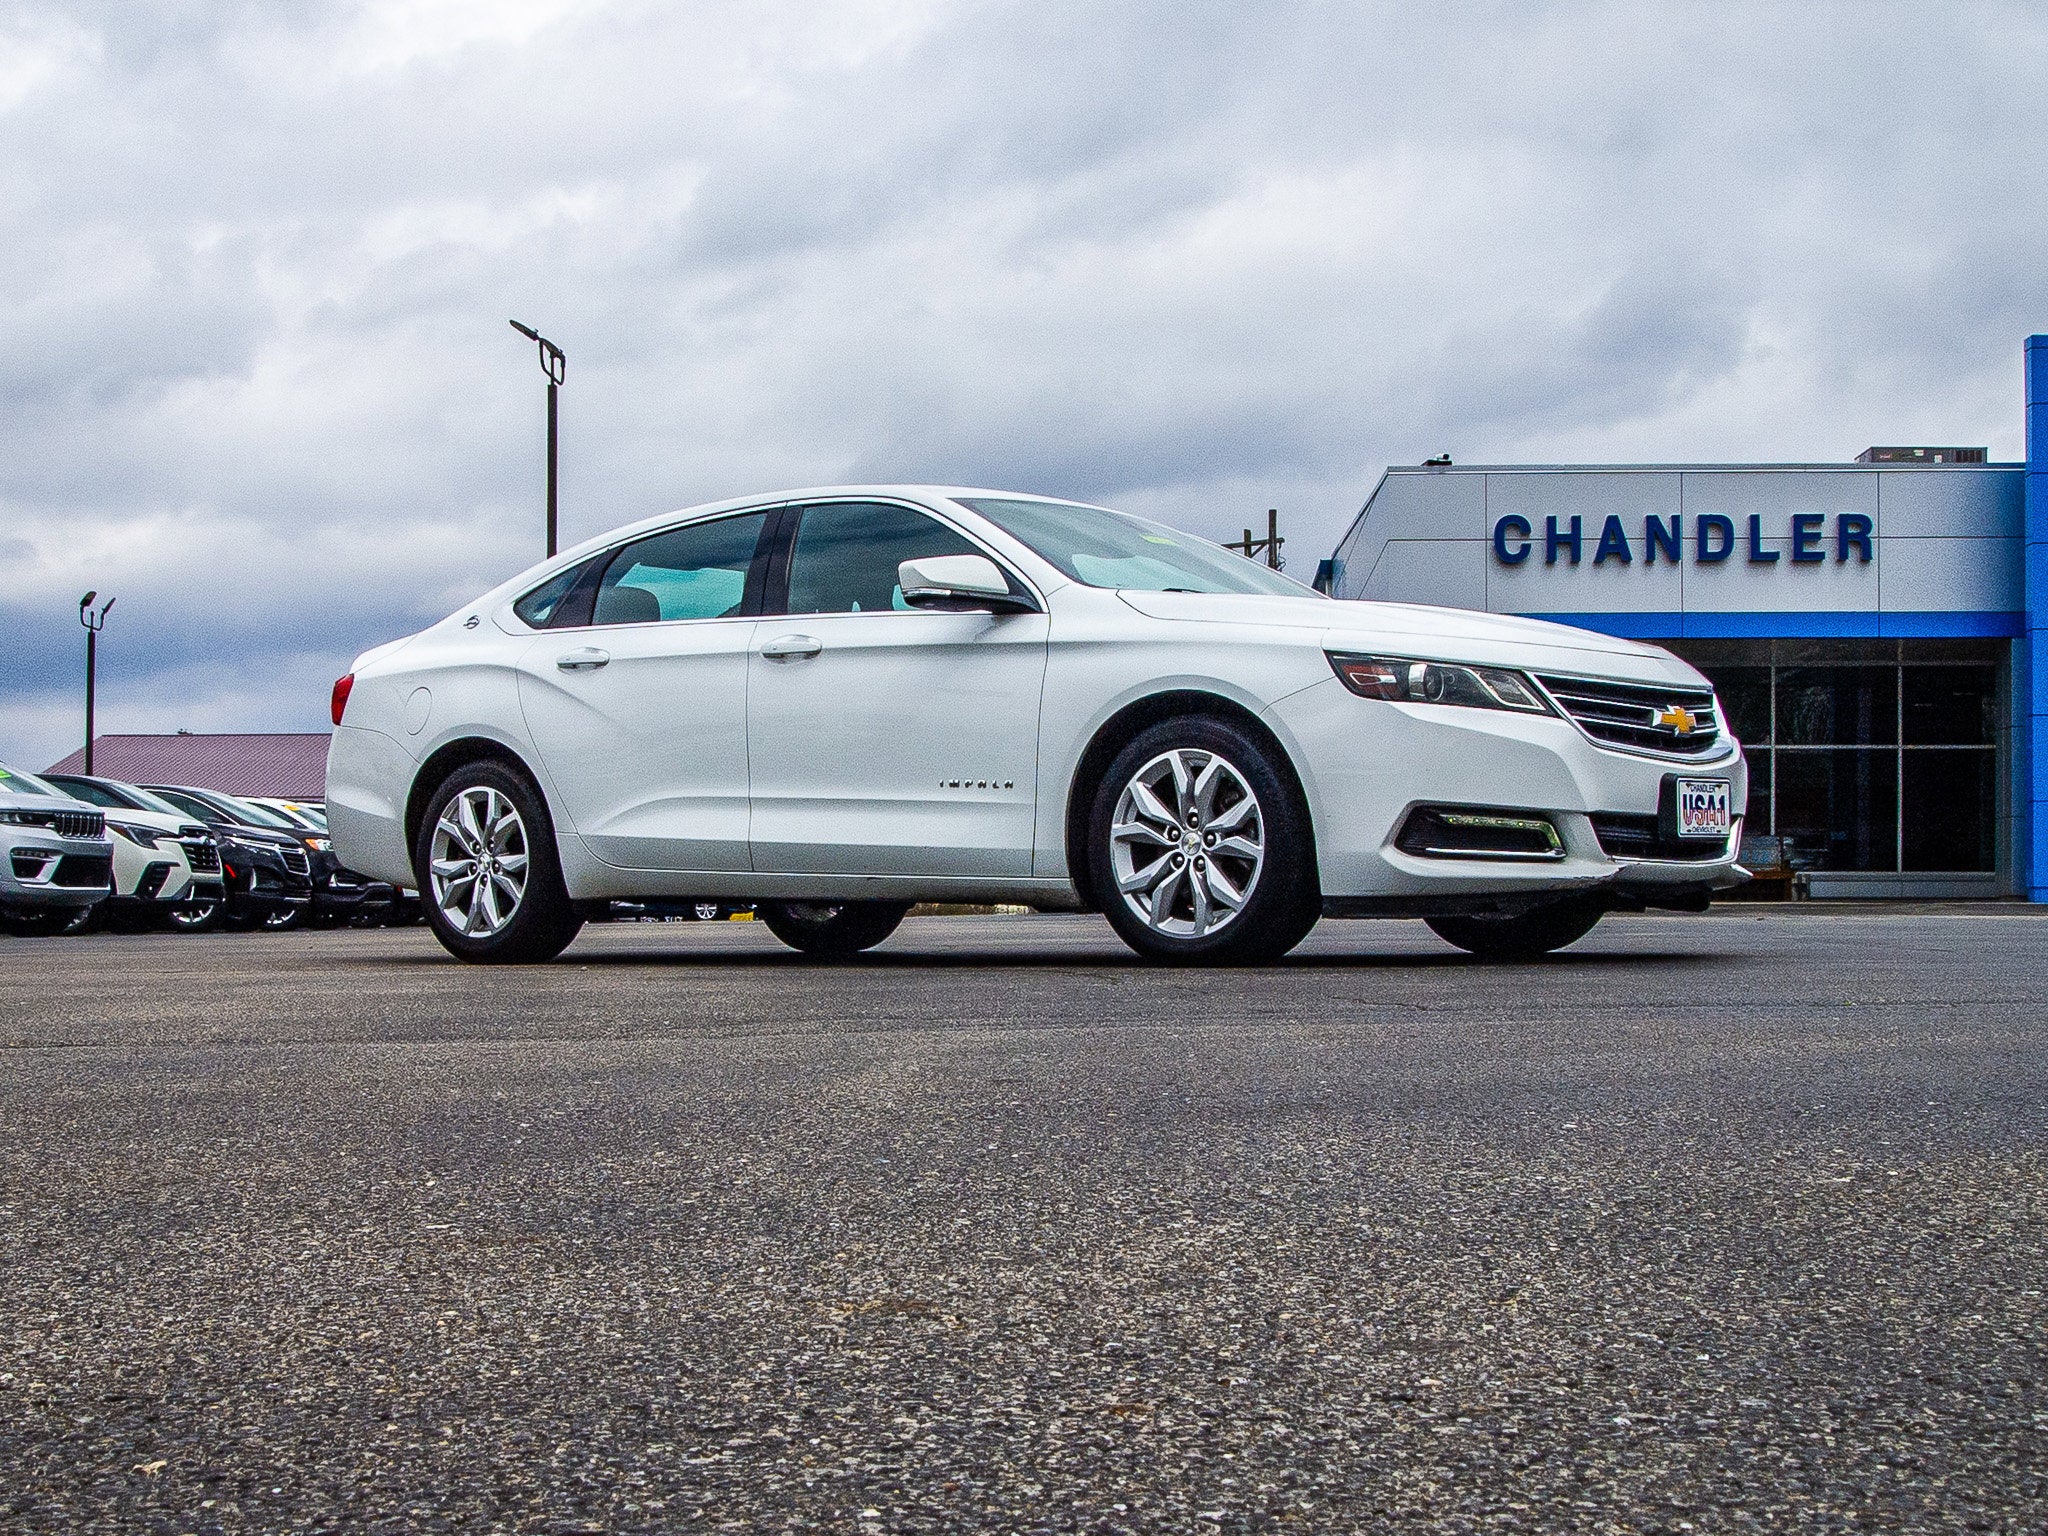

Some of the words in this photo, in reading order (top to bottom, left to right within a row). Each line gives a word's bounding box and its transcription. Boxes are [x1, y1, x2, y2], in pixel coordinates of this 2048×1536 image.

[1493, 513, 1874, 563] CHANDLER
[939, 779, 1014, 789] IMPALA
[1691, 784, 1716, 793] CHANDLER
